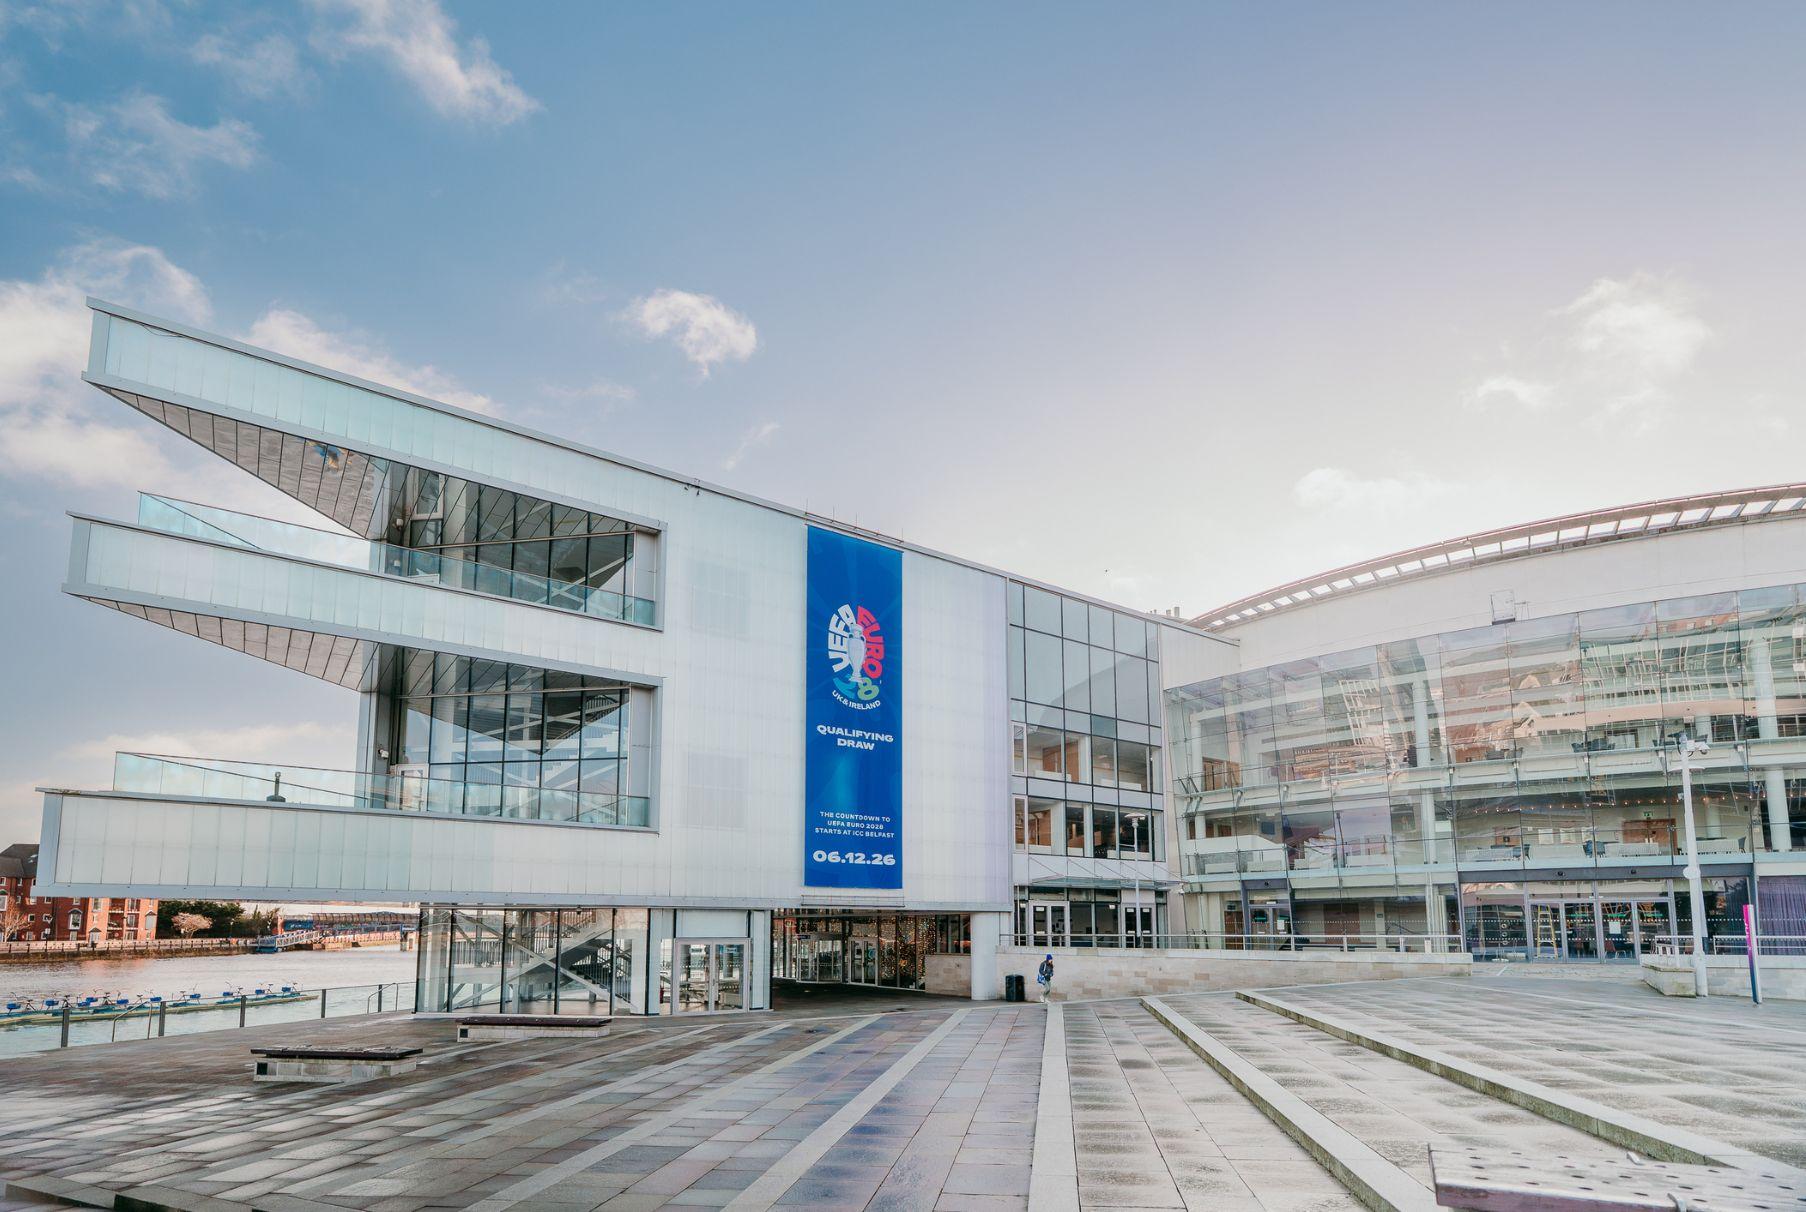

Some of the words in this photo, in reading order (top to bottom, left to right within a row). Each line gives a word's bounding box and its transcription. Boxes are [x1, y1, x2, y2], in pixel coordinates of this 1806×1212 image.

[828, 604, 856, 673] UEFA
[857, 605, 885, 679] EURO
[849, 699, 881, 710] IRELAND
[816, 724, 894, 743] QUALIFYING
[837, 738, 875, 751] DRAW
[835, 813, 880, 822] COUNTDOWN
[814, 827, 842, 835] STARTS
[827, 820, 845, 828] UEFA
[846, 821, 865, 829] EURO
[812, 850, 896, 866] 06.12.26
